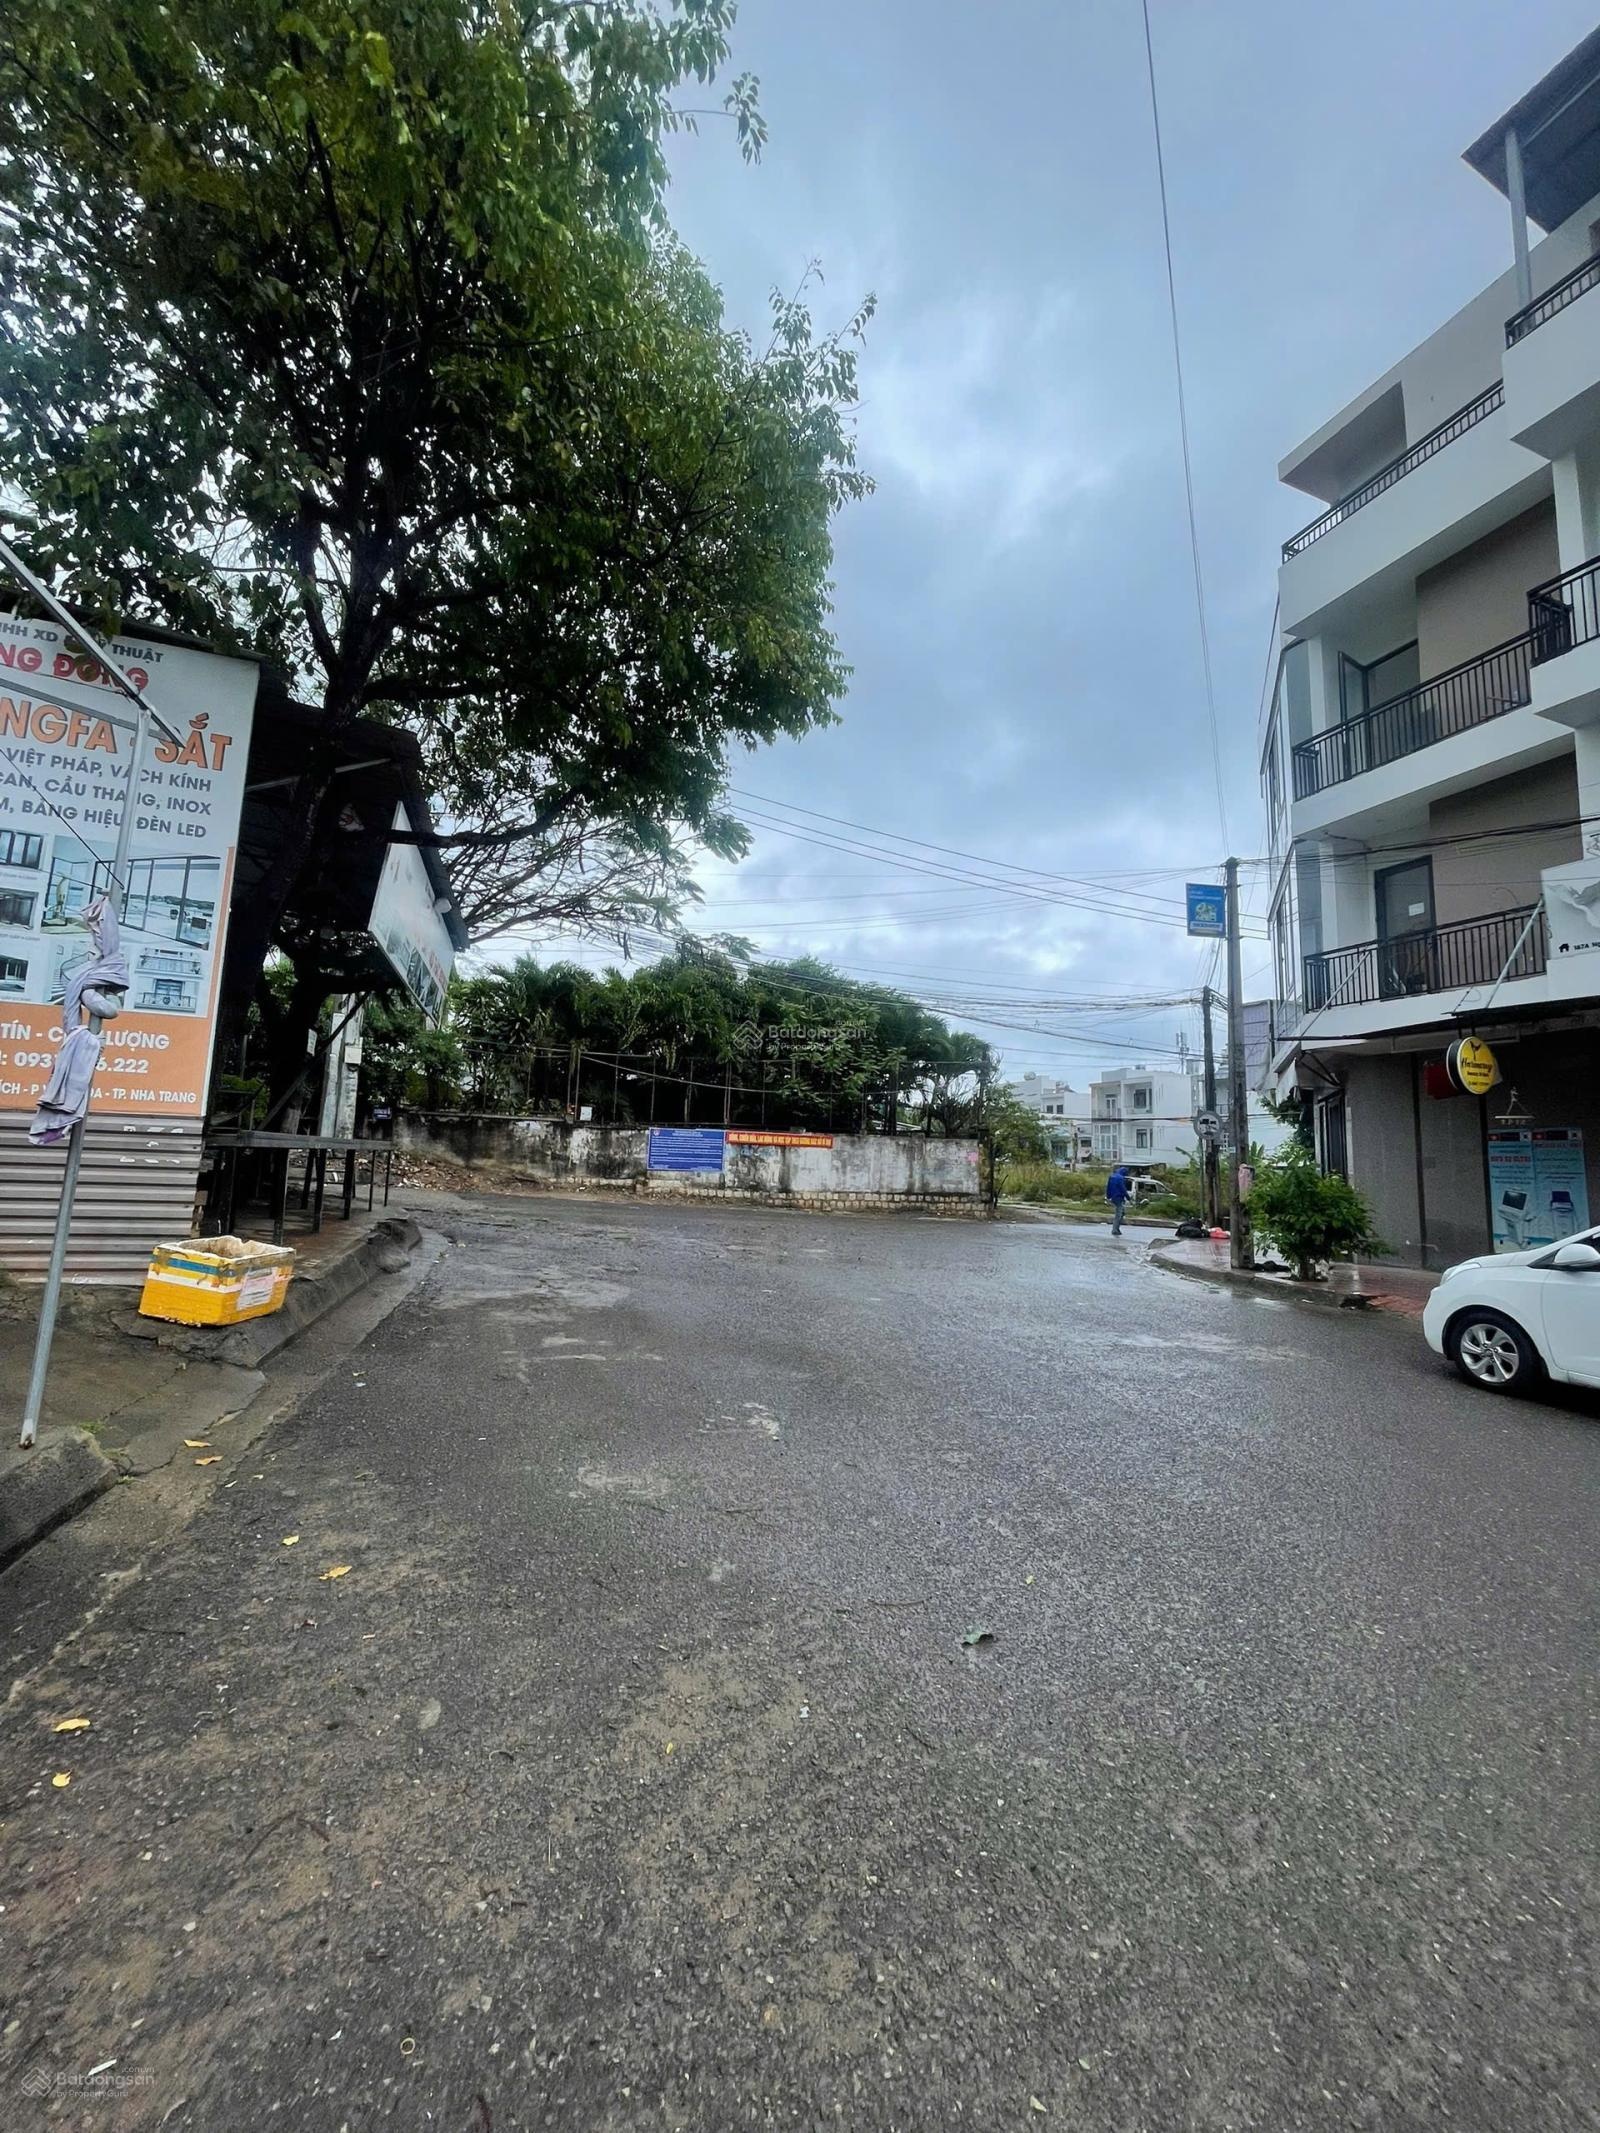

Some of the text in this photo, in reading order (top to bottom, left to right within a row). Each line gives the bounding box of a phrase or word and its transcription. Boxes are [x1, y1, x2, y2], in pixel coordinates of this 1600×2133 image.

[33, 628, 59, 642] XD
[112, 643, 164, 663] THUẬT
[155, 712, 232, 772] SẮT
[7, 746, 46, 768] VIỆT
[50, 756, 104, 777] PHÁP,
[169, 773, 212, 793] KÍNH
[21, 798, 79, 821] BẢNG
[136, 814, 171, 833] ĐÈN
[177, 824, 207, 839] LED
[92, 786, 161, 811] THAG,
[166, 796, 212, 816] INOX
[0, 1019, 31, 1041] TÍN
[106, 1030, 170, 1052] LƯỢNG
[130, 1089, 155, 1102] NHA
[159, 1091, 196, 1104] TRANG
